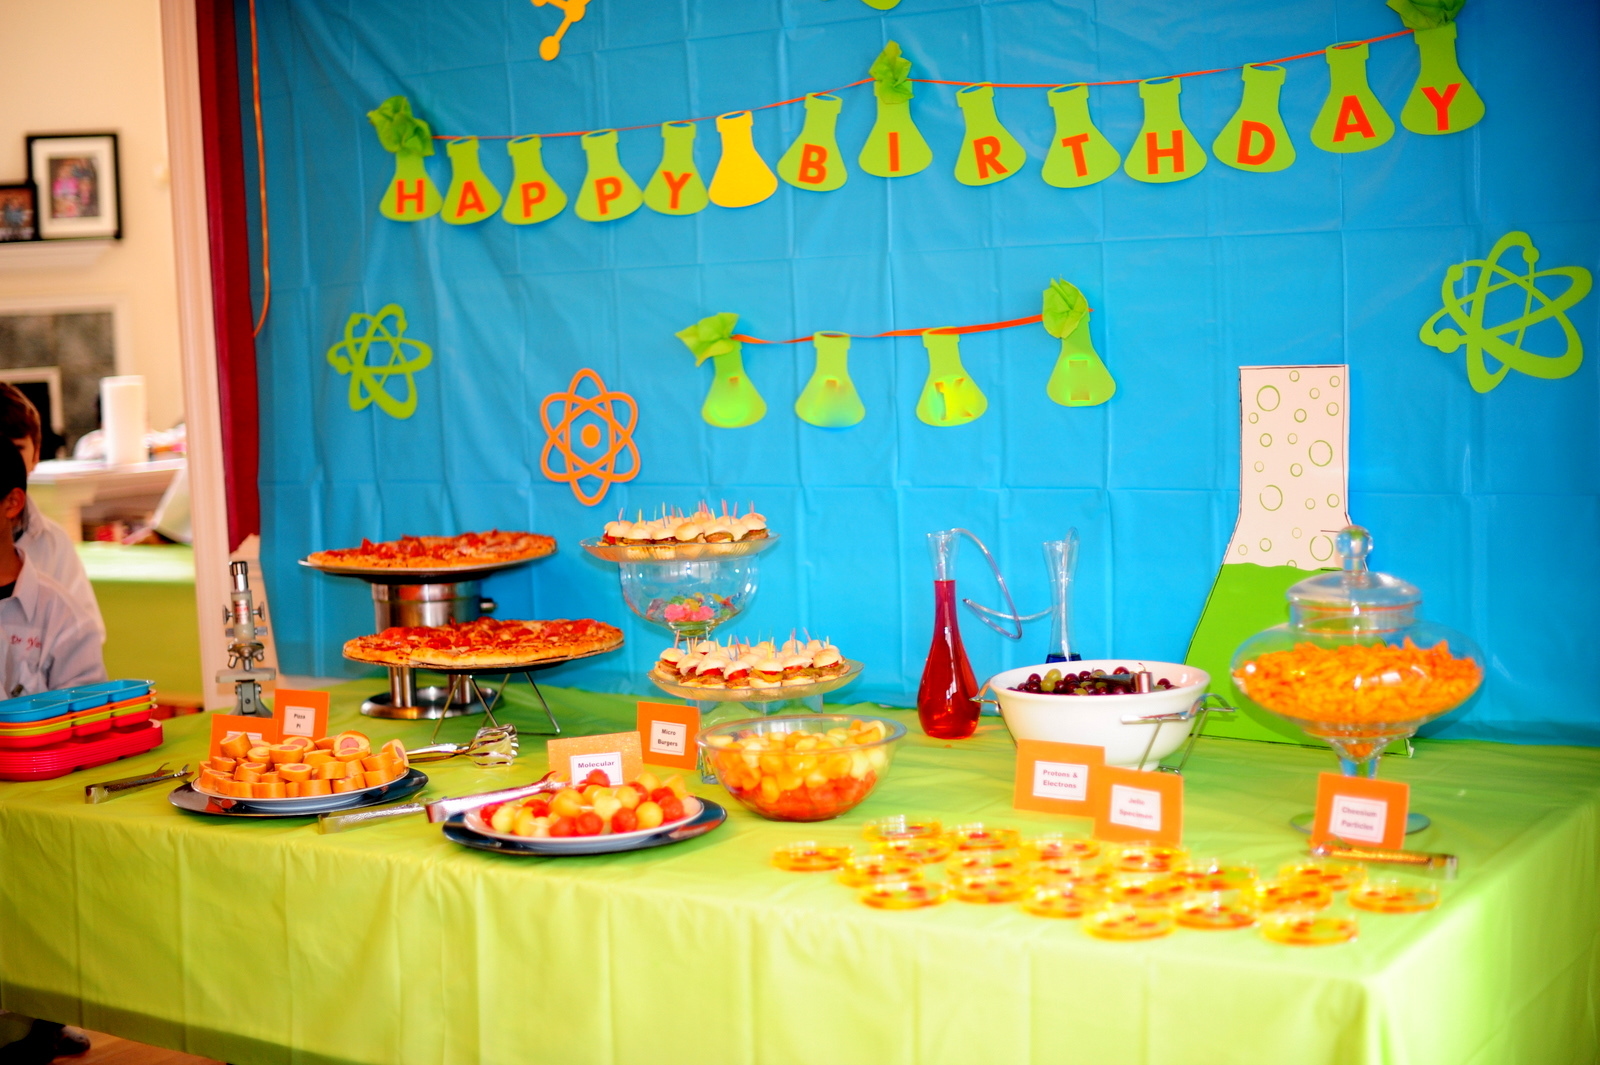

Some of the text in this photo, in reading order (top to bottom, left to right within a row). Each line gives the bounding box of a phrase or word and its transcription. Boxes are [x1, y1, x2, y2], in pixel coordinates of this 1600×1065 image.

[396, 83, 1462, 218] HAPPY BIRTHDAY
[661, 728, 677, 736] Micro
[657, 739, 678, 747] Burgers
[577, 760, 615, 768] Molecular
[1043, 769, 1070, 778] Protons
[1043, 779, 1077, 789] Electrons
[1128, 797, 1145, 805] Jello
[1119, 809, 1153, 820] Specimen
